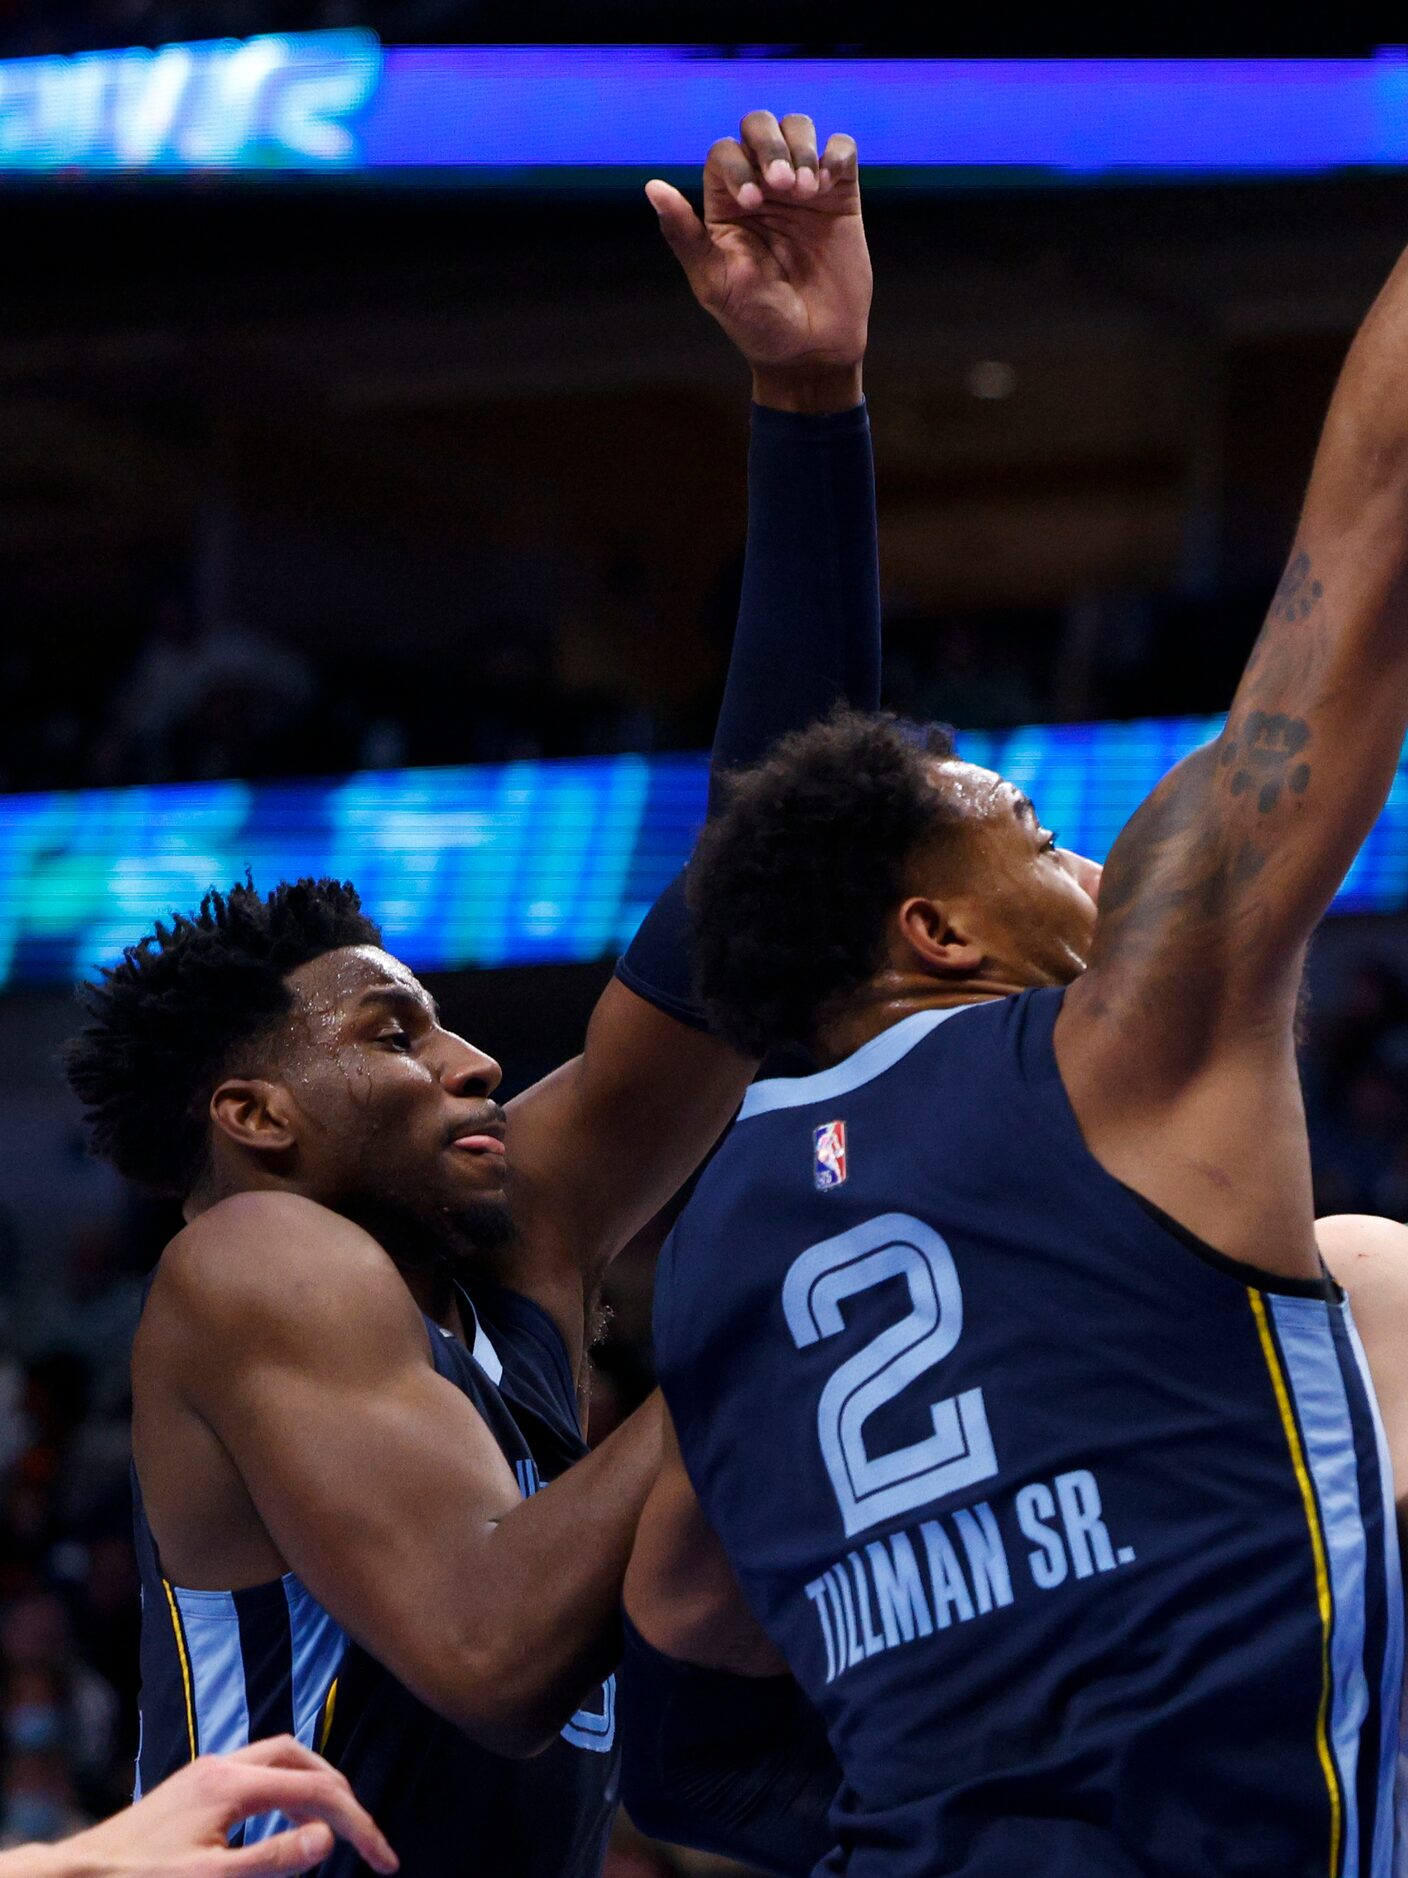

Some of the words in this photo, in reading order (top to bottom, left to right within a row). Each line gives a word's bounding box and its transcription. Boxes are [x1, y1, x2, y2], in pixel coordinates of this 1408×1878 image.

[782, 1213, 998, 1538] 2
[805, 1502, 1014, 1684] TILLMAN
[1015, 1469, 1136, 1589] SR.
